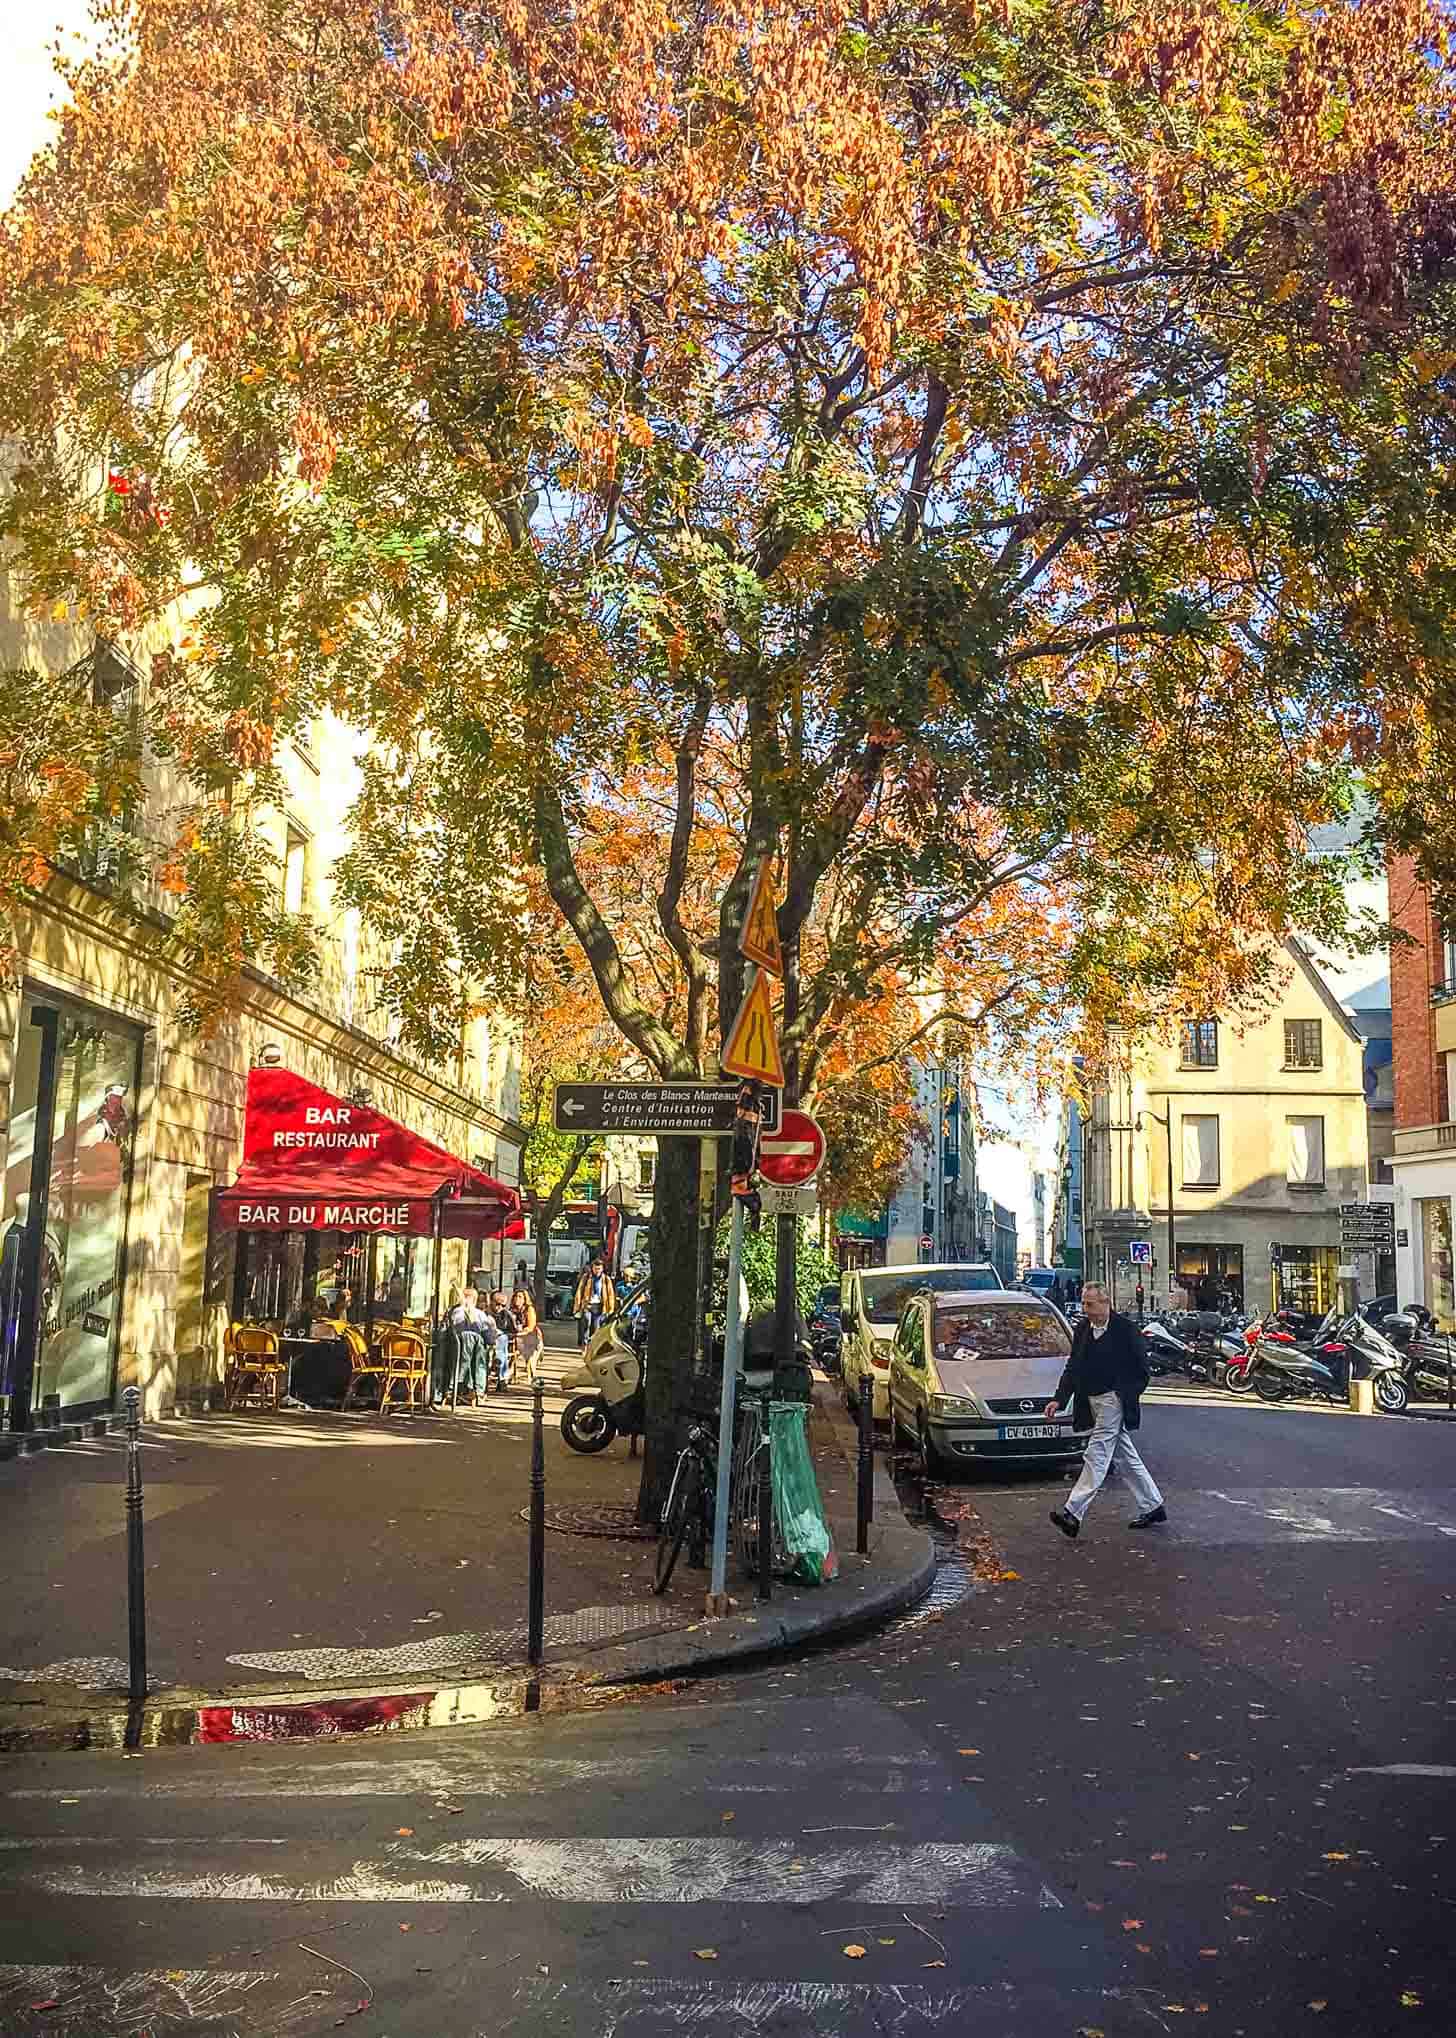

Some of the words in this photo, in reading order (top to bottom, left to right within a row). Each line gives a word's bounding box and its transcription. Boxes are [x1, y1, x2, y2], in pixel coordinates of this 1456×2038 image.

[603, 1089, 615, 1100] Le
[617, 1089, 638, 1100] Clos
[641, 1089, 657, 1100] des
[660, 1089, 691, 1101] Blancs
[305, 1107, 351, 1125] BAR
[273, 1131, 380, 1149] RESTAURANT
[238, 1205, 280, 1223] BAR
[288, 1206, 316, 1224] DU
[324, 1204, 409, 1225] MARCHÉ
